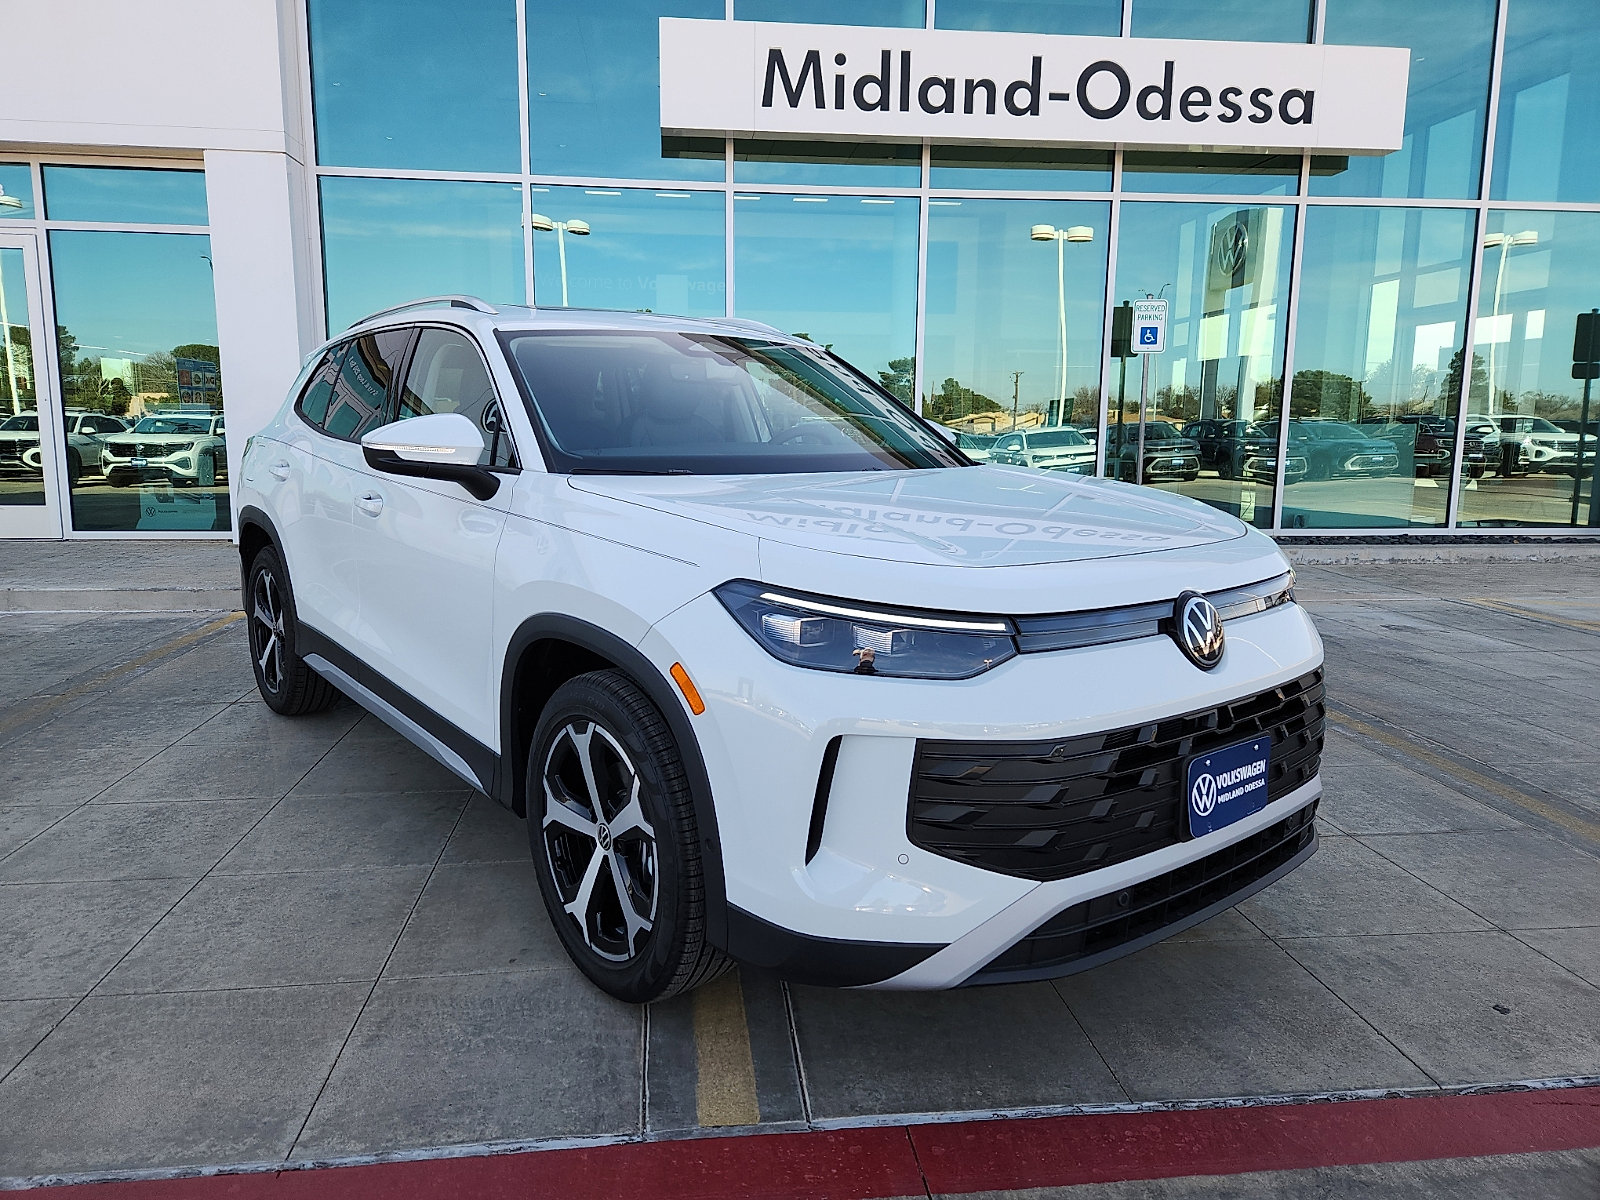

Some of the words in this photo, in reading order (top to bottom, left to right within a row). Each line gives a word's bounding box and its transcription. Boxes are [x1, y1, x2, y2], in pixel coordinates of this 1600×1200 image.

[761, 48, 1315, 125] Midland-Odessa
[1135, 304, 1166, 312] RESERVED
[1137, 313, 1163, 321] PARKING
[1216, 759, 1266, 789] VOLKSWAGEN
[1217, 786, 1244, 804] MIDLAND
[1244, 778, 1266, 793] ODESSA
